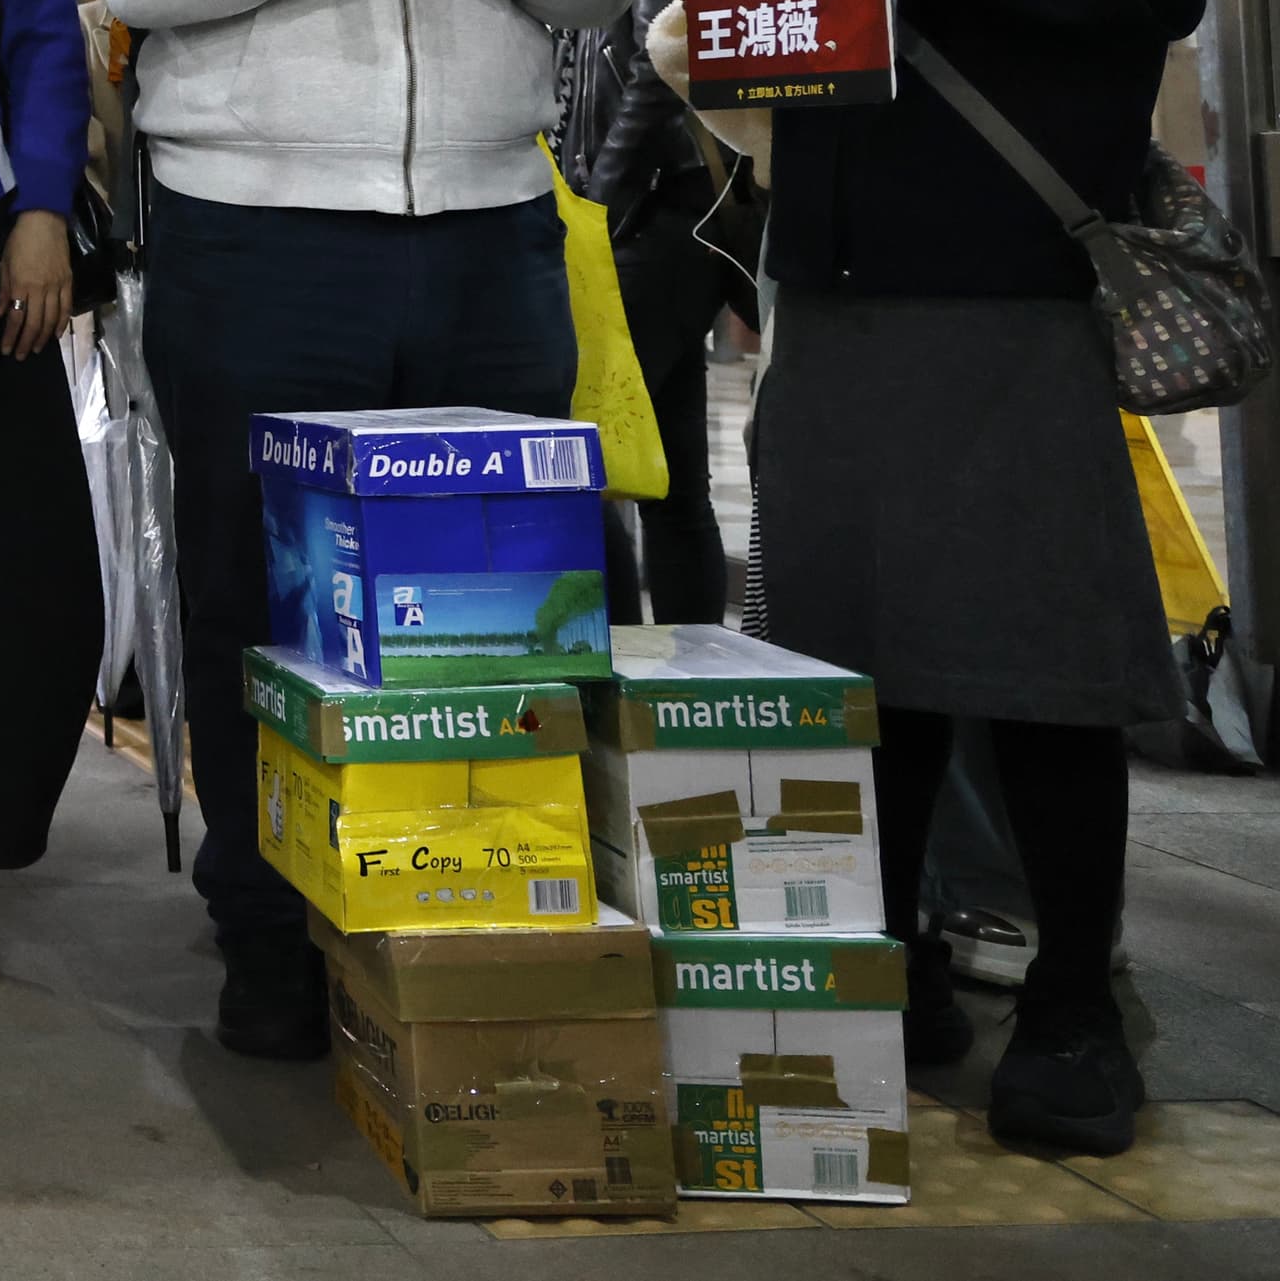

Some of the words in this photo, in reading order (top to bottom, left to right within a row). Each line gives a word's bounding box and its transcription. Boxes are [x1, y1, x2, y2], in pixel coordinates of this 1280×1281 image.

[263, 432, 316, 471] Double
[323, 441, 334, 474] A
[369, 452, 472, 478] Double
[482, 451, 504, 475] A
[342, 705, 491, 742] smartist
[657, 695, 792, 728] martist
[799, 708, 828, 726] A4
[356, 850, 400, 877] First
[411, 846, 462, 874] Copy
[482, 848, 511, 868] 70
[517, 843, 530, 853] A4
[518, 854, 538, 865] 500
[660, 869, 728, 887] smartist
[675, 958, 816, 992] martist
